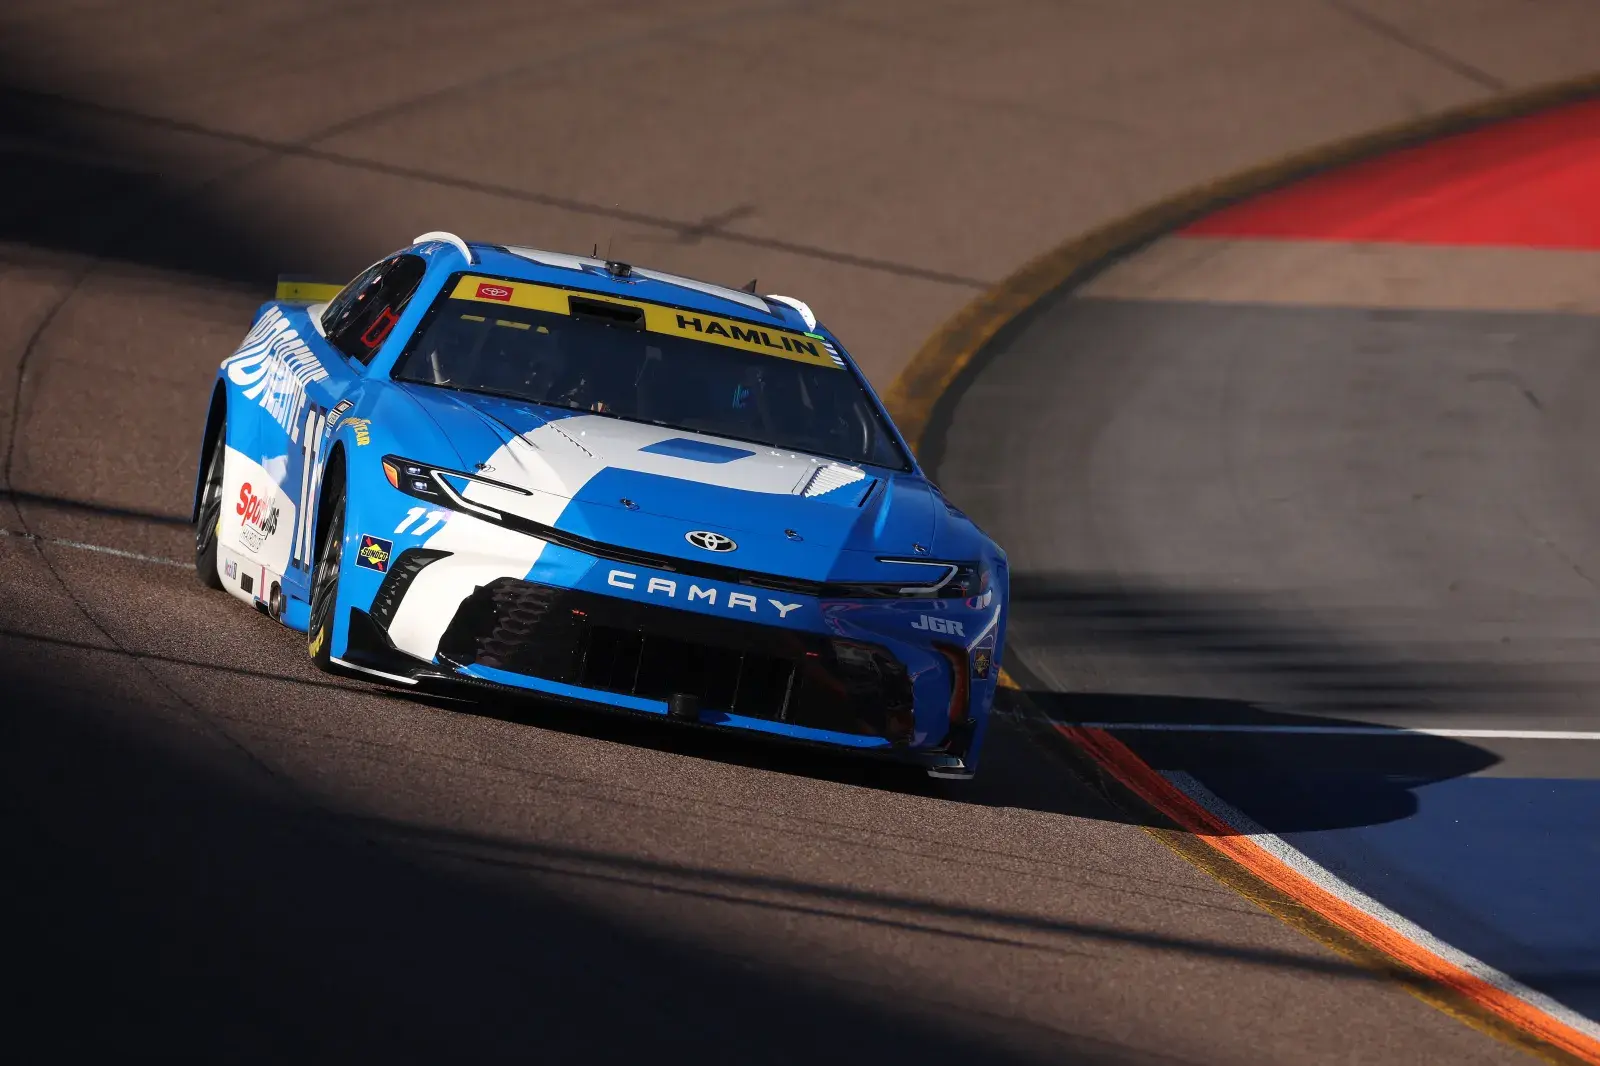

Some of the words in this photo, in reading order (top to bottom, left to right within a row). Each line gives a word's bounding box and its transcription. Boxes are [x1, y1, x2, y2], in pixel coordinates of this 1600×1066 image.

[676, 314, 820, 357] HAMLIN
[394, 507, 445, 536] 11
[361, 547, 388, 561] SUNOCO
[608, 569, 803, 618] CAMRY
[911, 614, 966, 637] JGR
